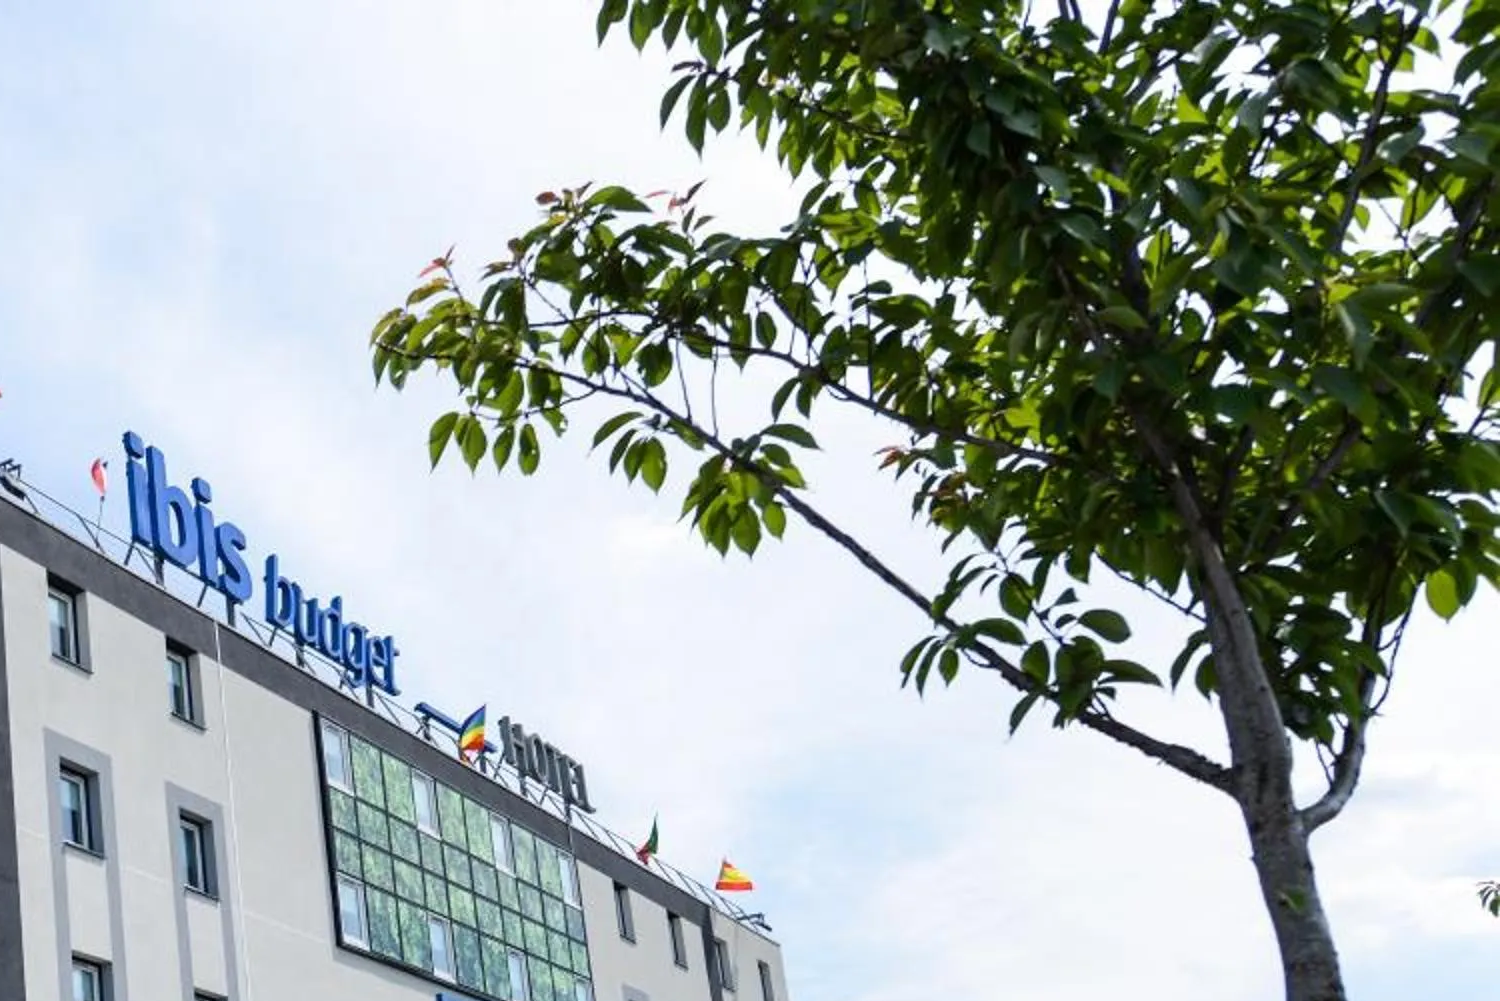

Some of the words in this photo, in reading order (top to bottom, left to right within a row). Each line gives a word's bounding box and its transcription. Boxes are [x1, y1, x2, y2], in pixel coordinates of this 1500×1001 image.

[122, 430, 252, 602] ibis
[264, 553, 401, 696] budget
[498, 715, 596, 814] HOTEL
